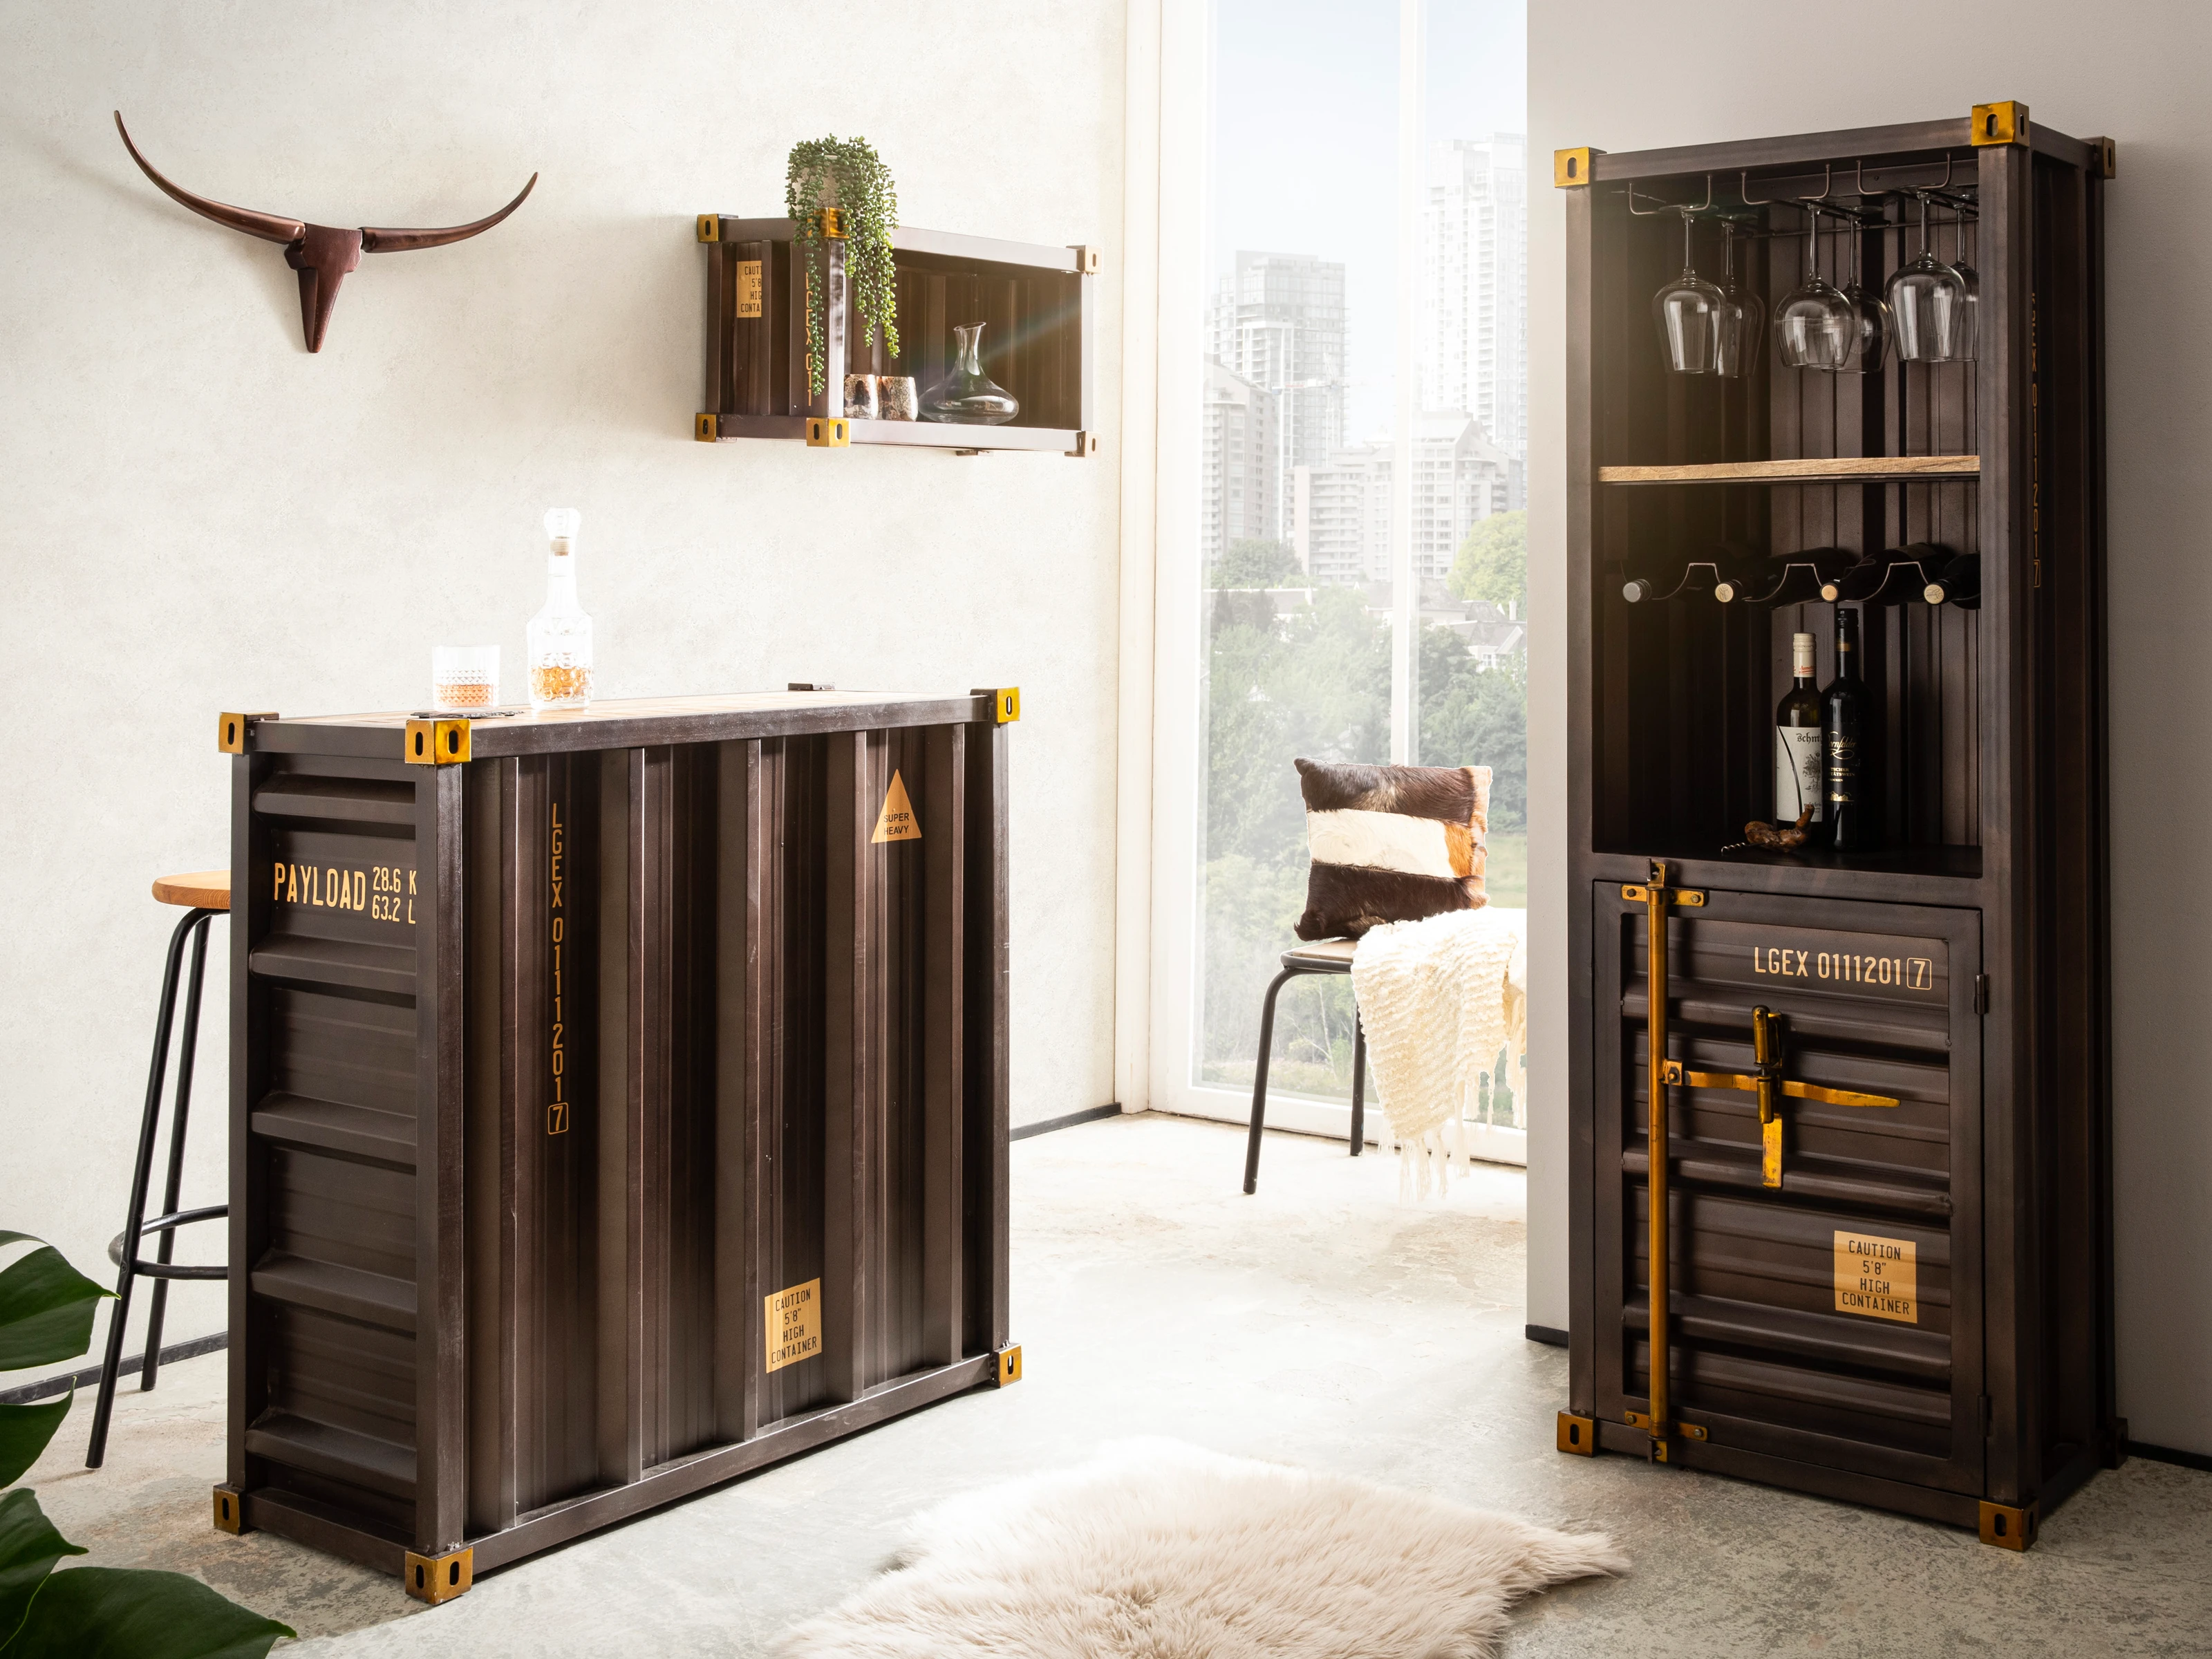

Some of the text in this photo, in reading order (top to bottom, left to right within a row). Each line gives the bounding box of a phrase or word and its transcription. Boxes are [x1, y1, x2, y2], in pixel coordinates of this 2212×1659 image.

[744, 265, 762, 275] CAUTI
[751, 278, 762, 288] 5'8
[750, 290, 762, 300] HIG
[740, 303, 760, 312] CONTA
[883, 812, 910, 823] SUPER
[883, 825, 910, 836] HEAVY
[552, 803, 563, 908] LGEX
[274, 862, 366, 911] PAYLOAD
[373, 866, 417, 895] 28.6 K
[371, 894, 416, 924] 63.2 L
[1754, 946, 1808, 977] LGEX
[1817, 952, 1901, 986] 0111201
[552, 917, 563, 1103] 0111201
[1848, 1239, 1901, 1260] CAUTION
[1863, 1260, 1886, 1275] 5'8"
[1860, 1277, 1890, 1295] HIGH
[775, 1288, 811, 1312] CAUTION
[1842, 1292, 1909, 1315] CONTAINER
[785, 1308, 802, 1325] 5'8"
[782, 1324, 805, 1343] HIGH
[771, 1336, 817, 1364] CONTAINER
